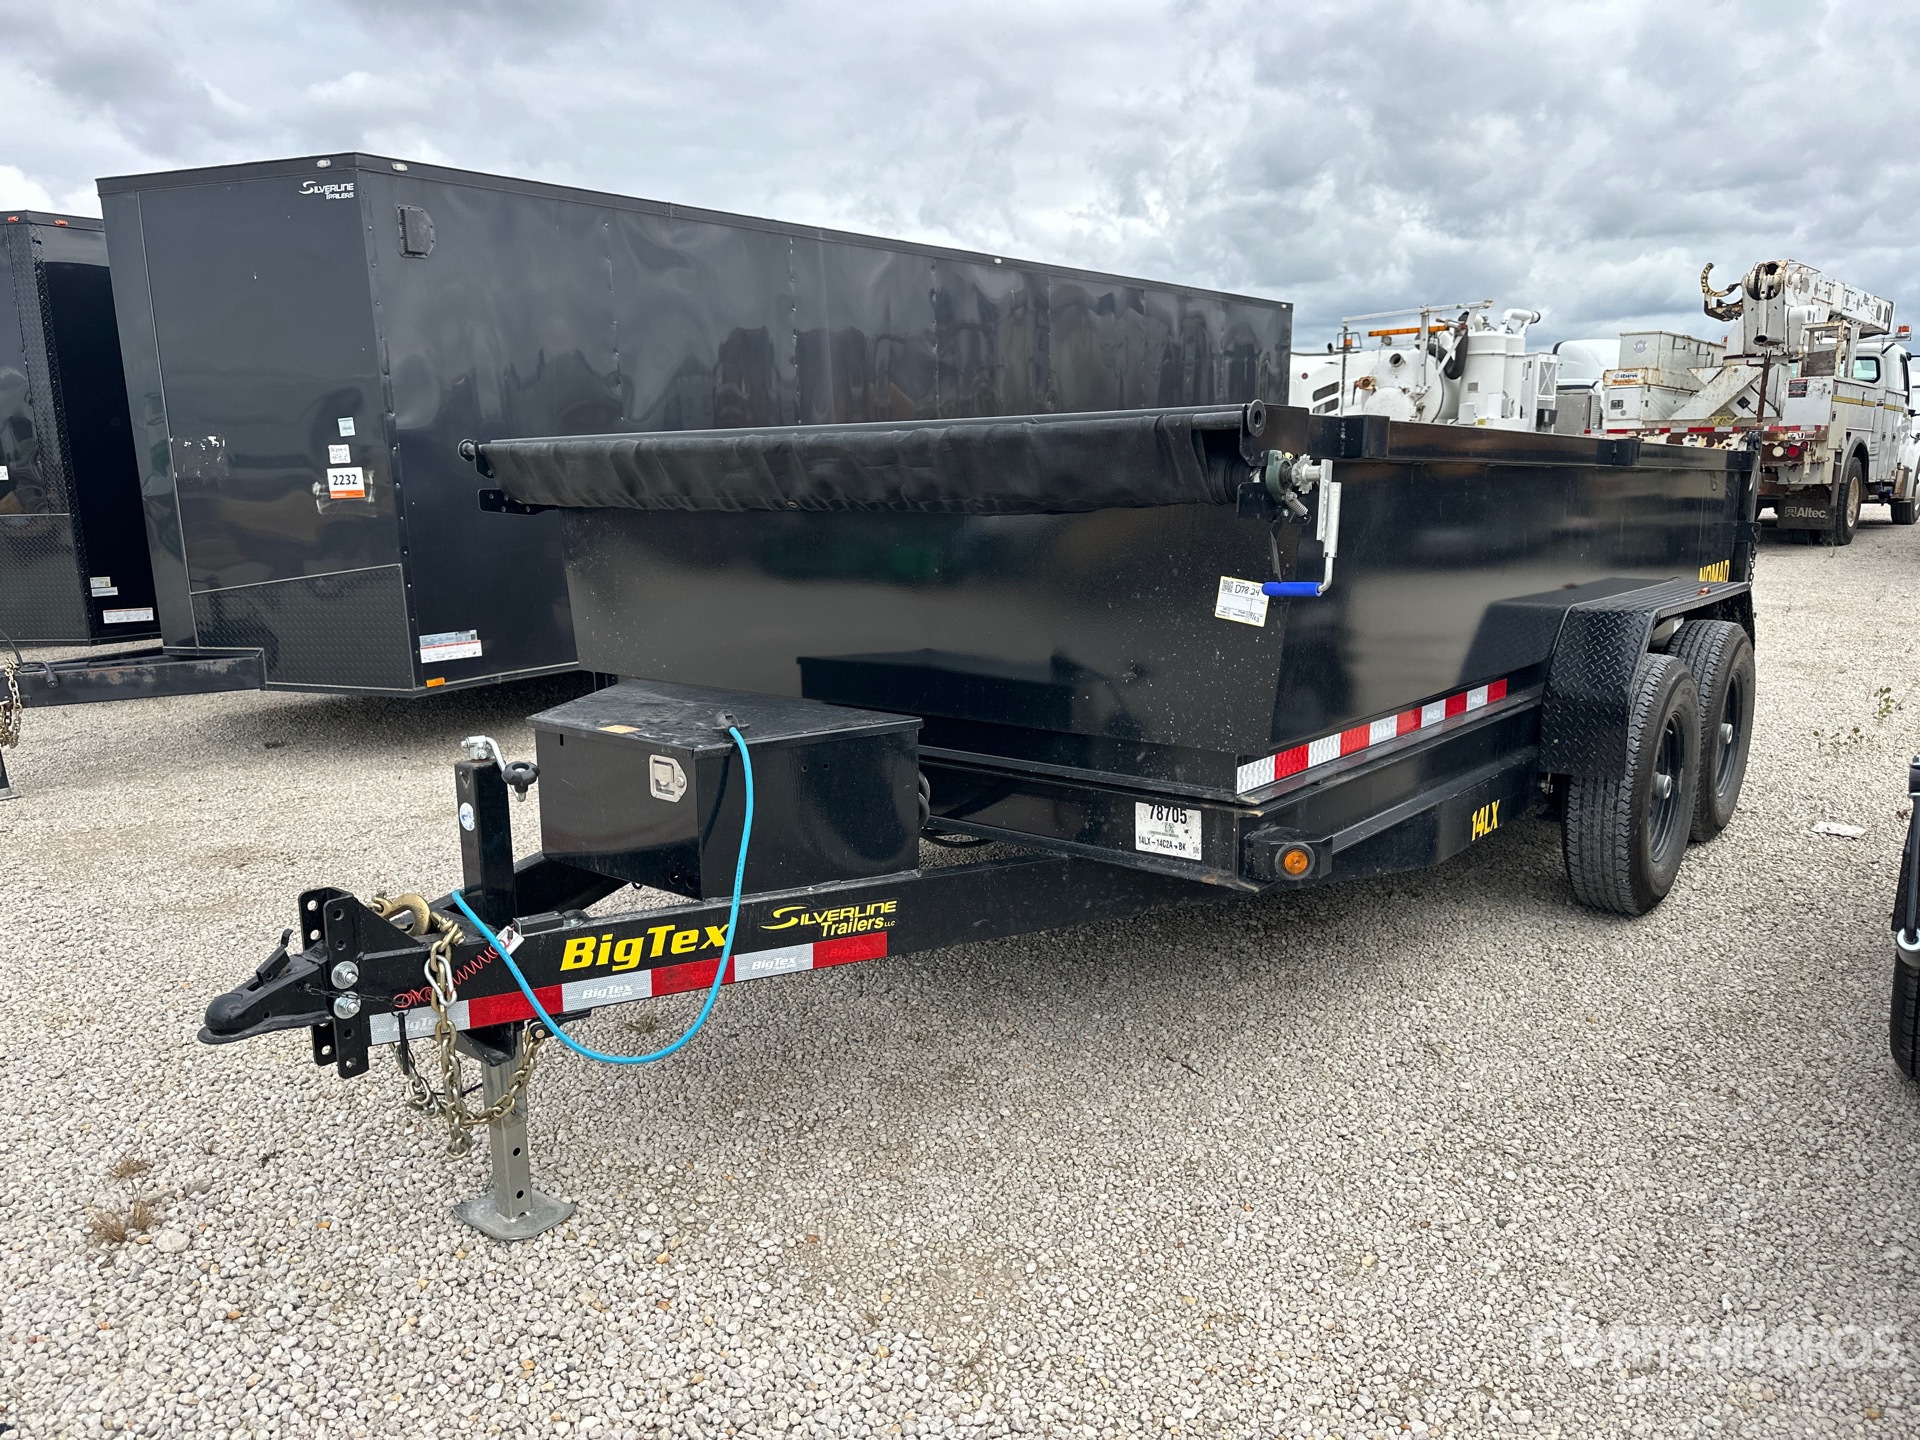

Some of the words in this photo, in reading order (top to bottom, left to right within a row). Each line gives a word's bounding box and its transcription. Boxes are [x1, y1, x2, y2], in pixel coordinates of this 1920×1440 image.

[299, 181, 354, 194] SILVERLINE
[332, 474, 358, 486] 2232
[1796, 507, 1826, 518] Altec
[1699, 559, 1730, 582] NOMAD
[1148, 804, 1188, 825] 78705
[1471, 799, 1500, 841] 14LX
[760, 900, 898, 930] SILVERLINE
[821, 916, 885, 937] Trailers
[884, 920, 896, 928] LLC
[560, 923, 729, 972] BigTex
[751, 956, 797, 971] BigTex
[581, 985, 633, 999] BigTex
